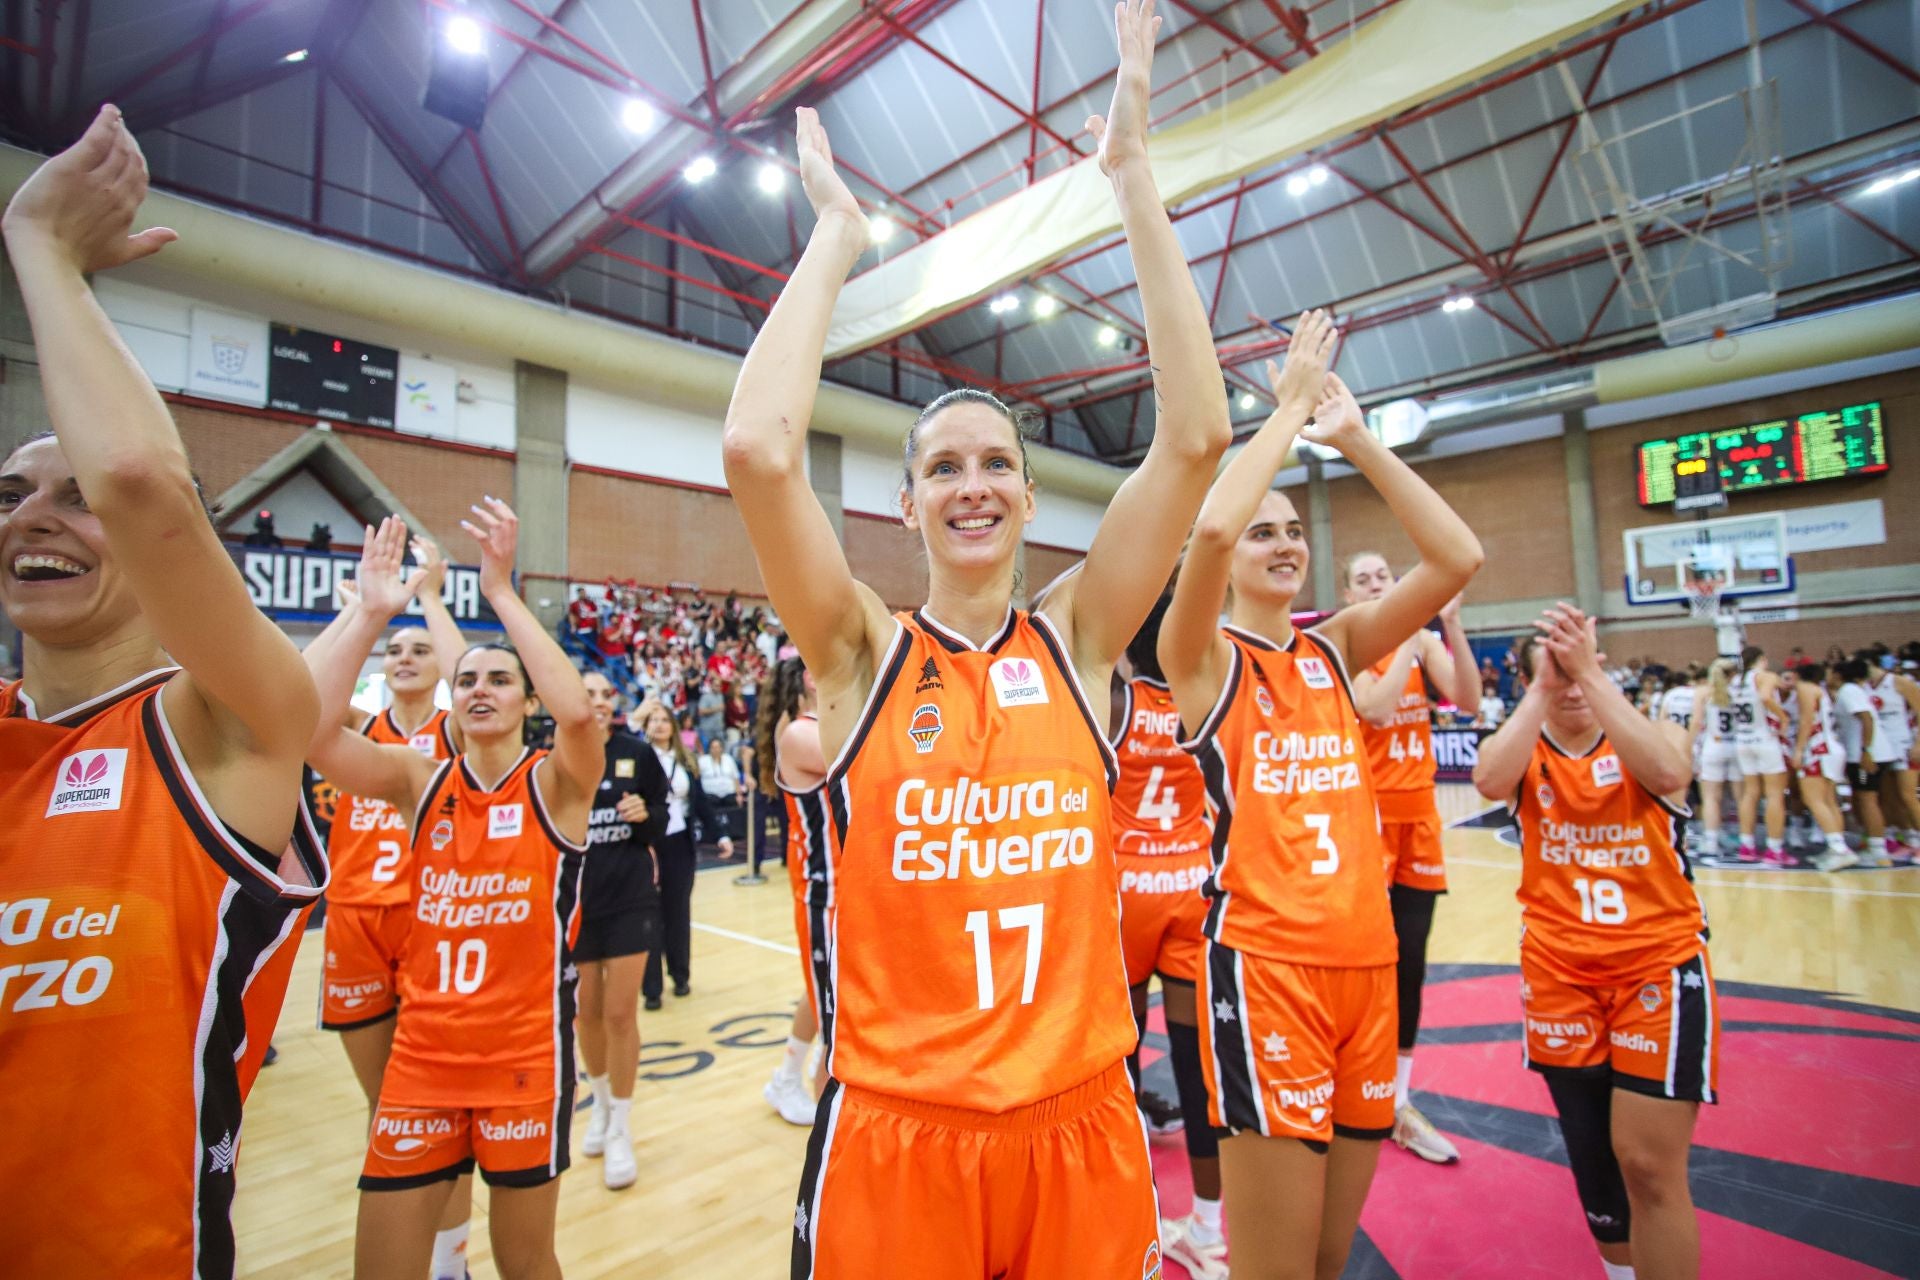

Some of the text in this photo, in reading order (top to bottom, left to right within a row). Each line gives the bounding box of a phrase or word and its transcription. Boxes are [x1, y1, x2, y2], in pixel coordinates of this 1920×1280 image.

[273, 345, 312, 363] LOCAL
[1388, 730, 1425, 764] 44
[1253, 761, 1361, 794] Esfuerz
[55, 787, 111, 805] SUPERCOPA
[895, 776, 1088, 826] Cultura del
[1136, 766, 1180, 831] 4
[1303, 813, 1340, 875] 3
[1540, 818, 1623, 842] Cultura
[371, 840, 401, 883] 2
[891, 826, 1094, 881] Esfuerzo
[1541, 841, 1651, 868] Esfuerzo
[420, 865, 532, 899] Cultura del
[416, 893, 531, 928] Esfuerzo
[1573, 878, 1628, 926] 18
[51, 904, 121, 940] del
[435, 938, 487, 994] 10
[964, 902, 1045, 1011] 17
[328, 981, 382, 998] PULEVA
[1527, 1018, 1588, 1036] PULEVA
[376, 1116, 451, 1136] PULEVA
